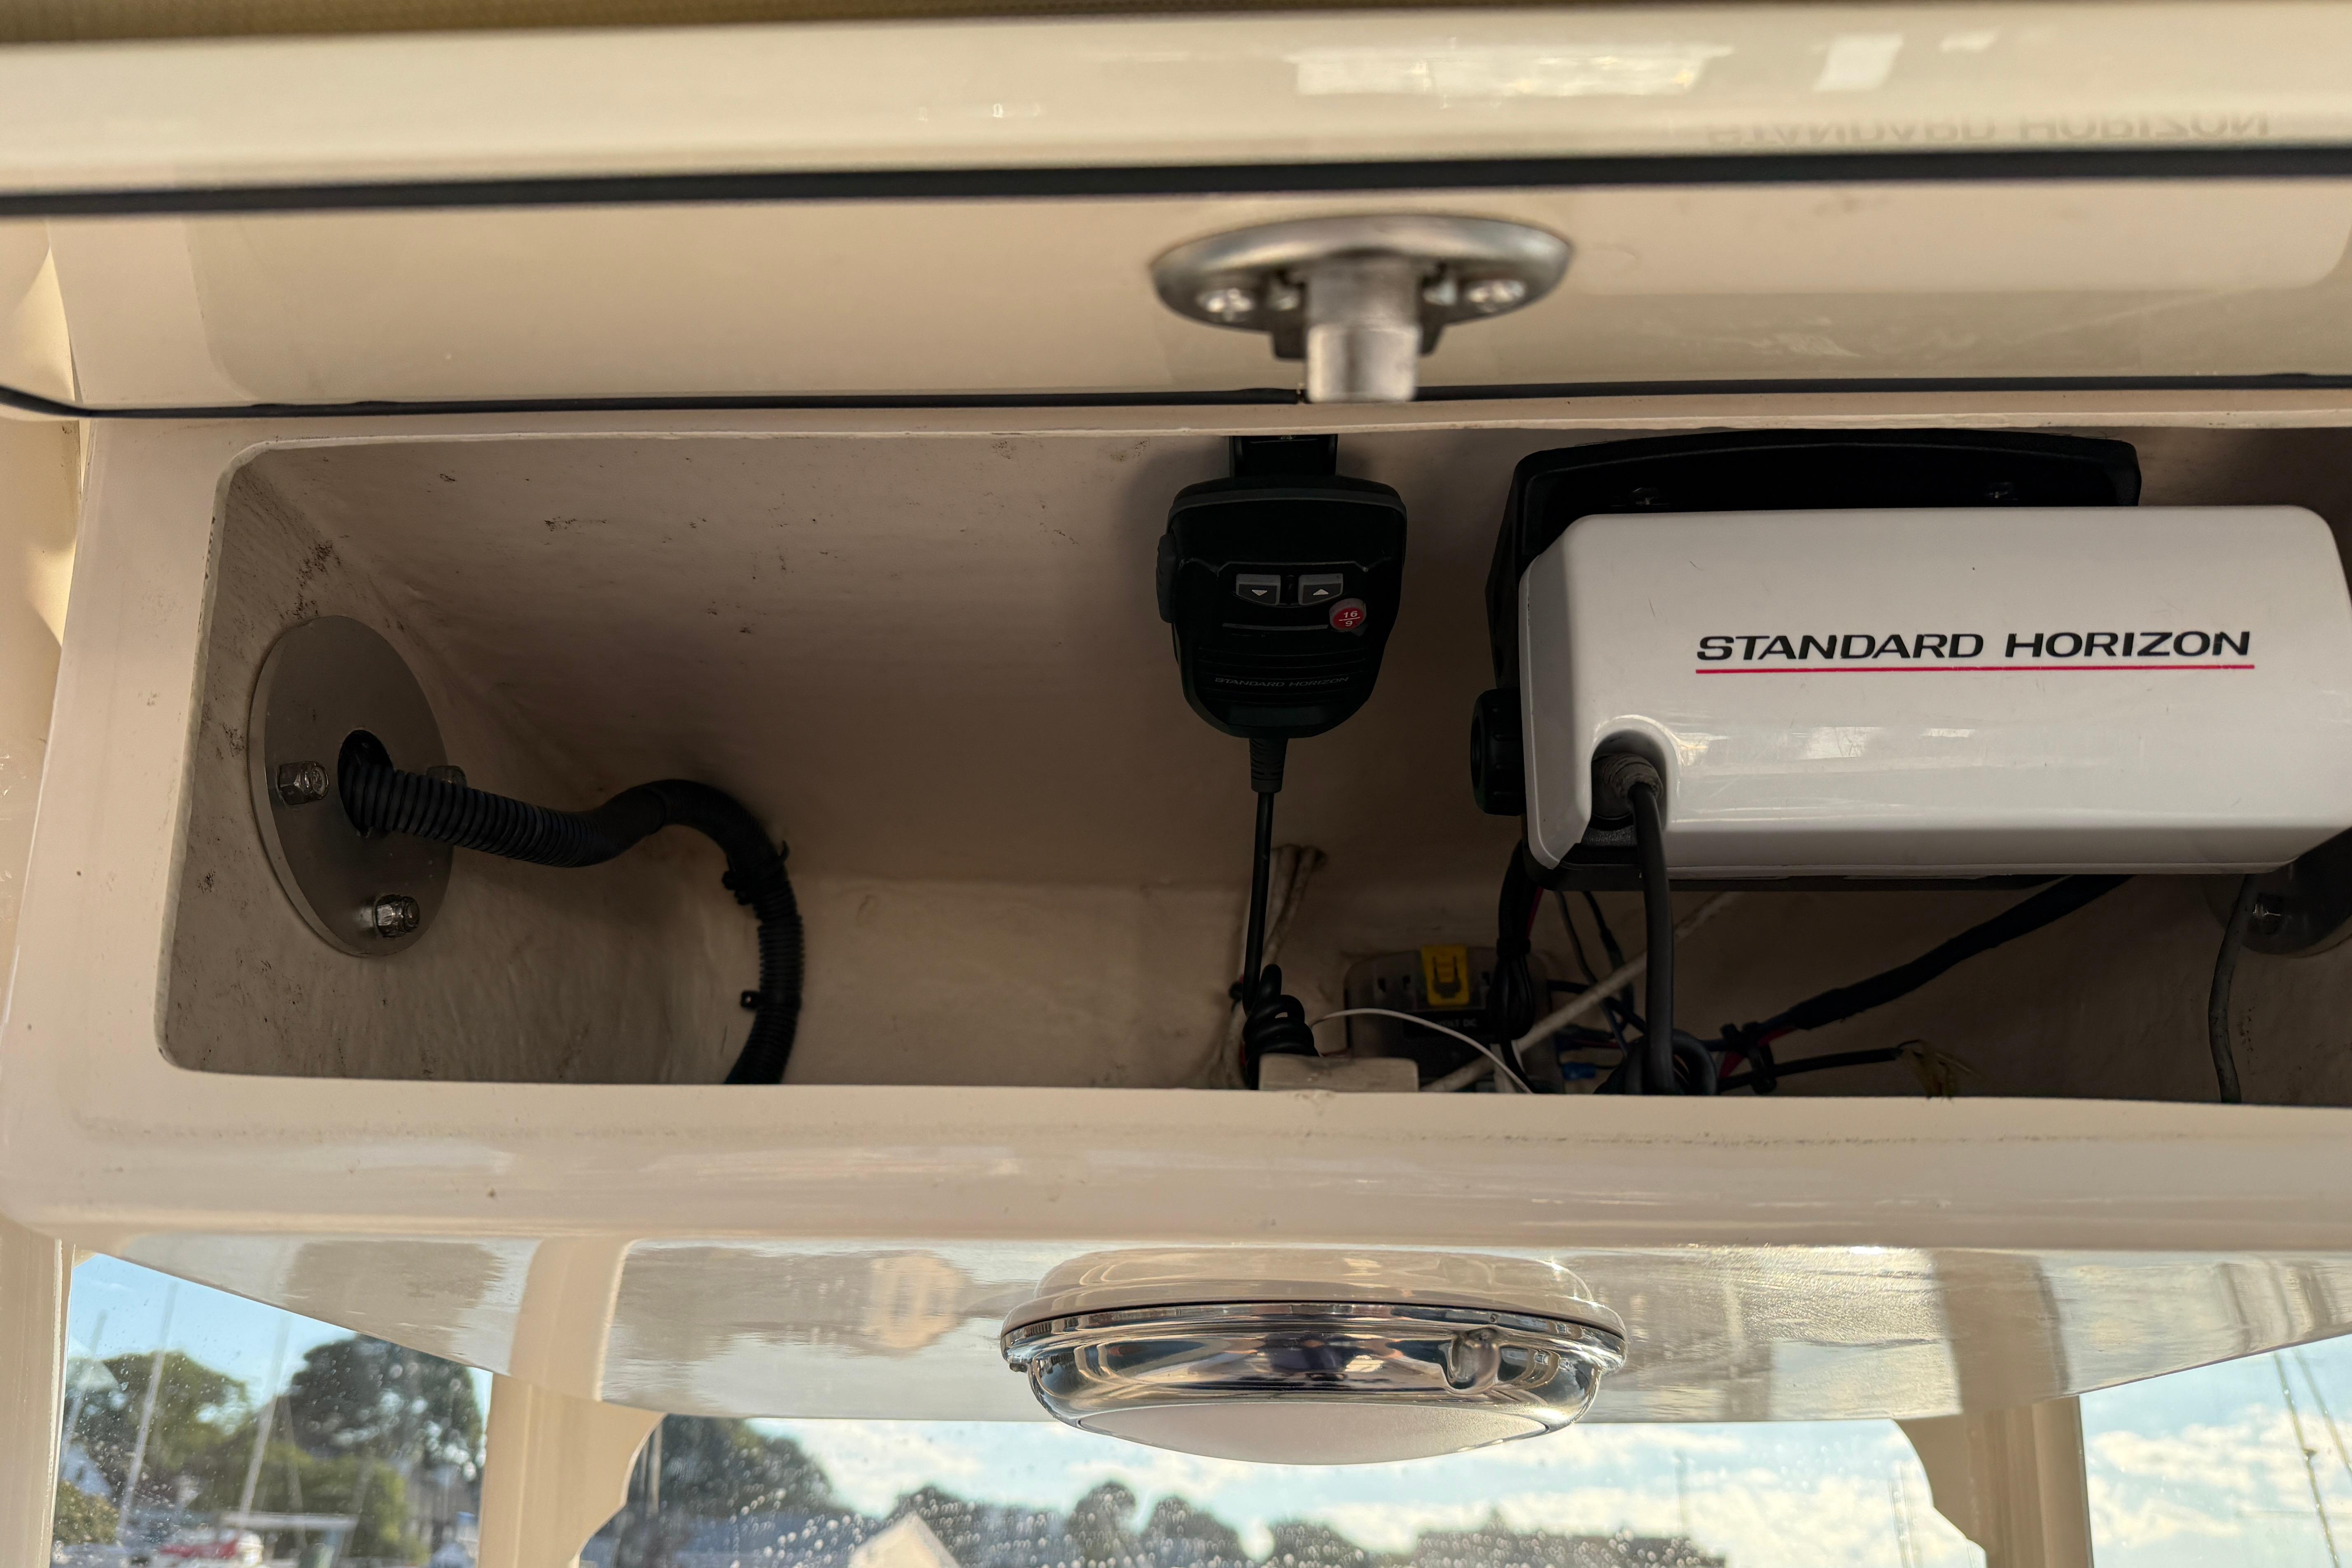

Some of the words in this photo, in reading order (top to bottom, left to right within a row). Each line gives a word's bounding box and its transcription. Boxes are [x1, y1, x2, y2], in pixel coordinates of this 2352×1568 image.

[1343, 610, 1358, 618] 16
[1697, 634, 1984, 660] STANDARD
[2005, 631, 2250, 658] HORIZON
[1214, 677, 1285, 687] STANDARD
[1288, 676, 1350, 687] HORIZON
